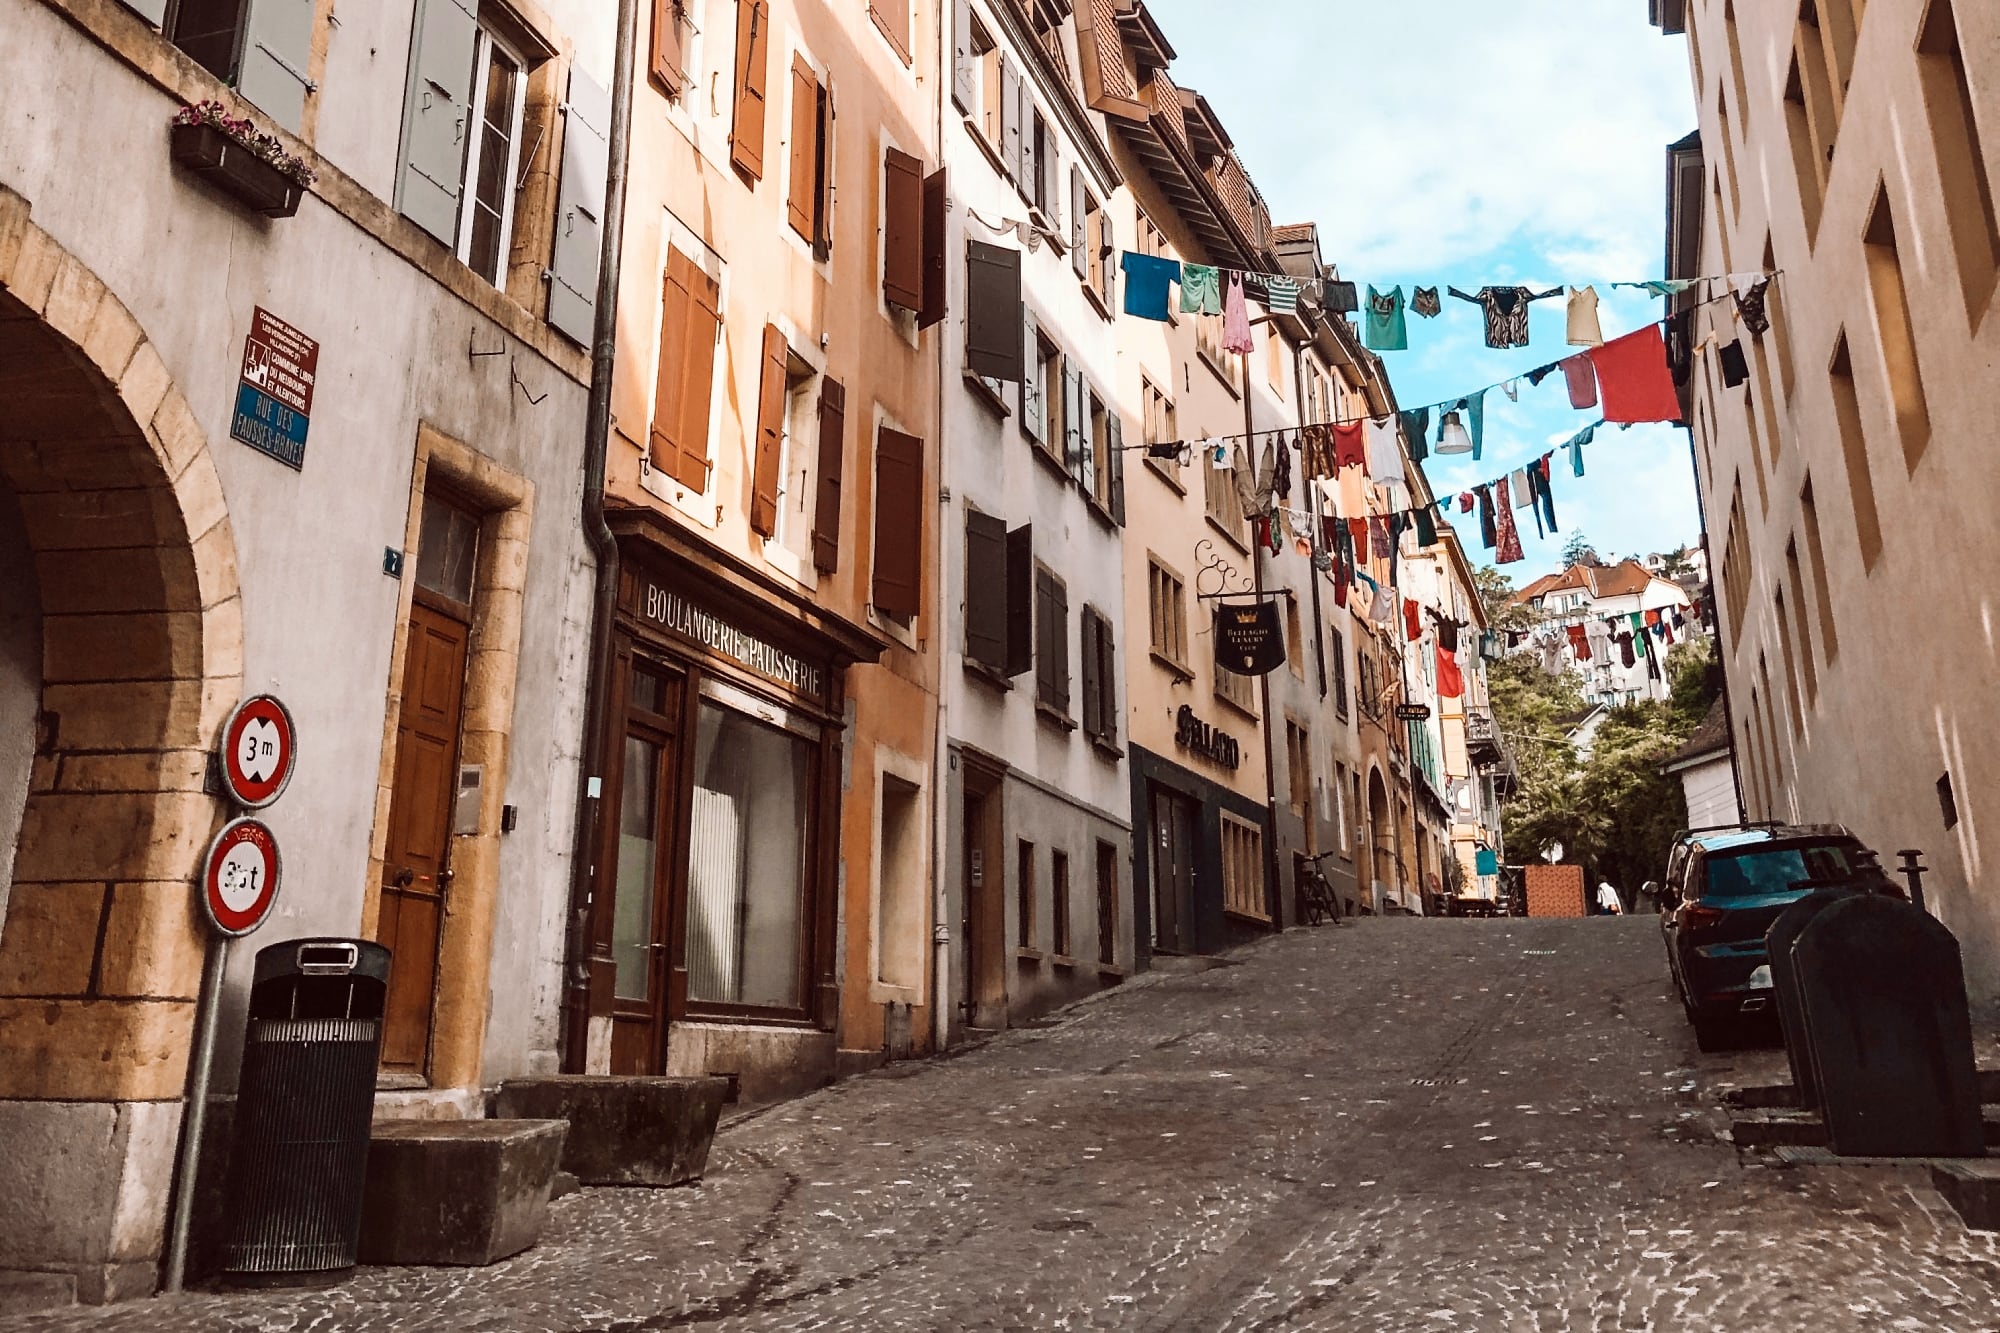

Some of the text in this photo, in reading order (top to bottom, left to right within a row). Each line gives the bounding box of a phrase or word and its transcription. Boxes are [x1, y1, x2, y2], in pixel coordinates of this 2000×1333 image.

[260, 312, 284, 330] COMMUNE
[270, 366, 306, 396] DU NEUBOURG
[272, 352, 314, 386] COMMUNE LIBRE
[268, 381, 306, 410] ET ALENTOURS
[256, 395, 294, 432] RUE DES
[236, 414, 304, 464] FAUSSES-BRAYES
[646, 584, 820, 697] BOULANGERIE PATISSERIE
